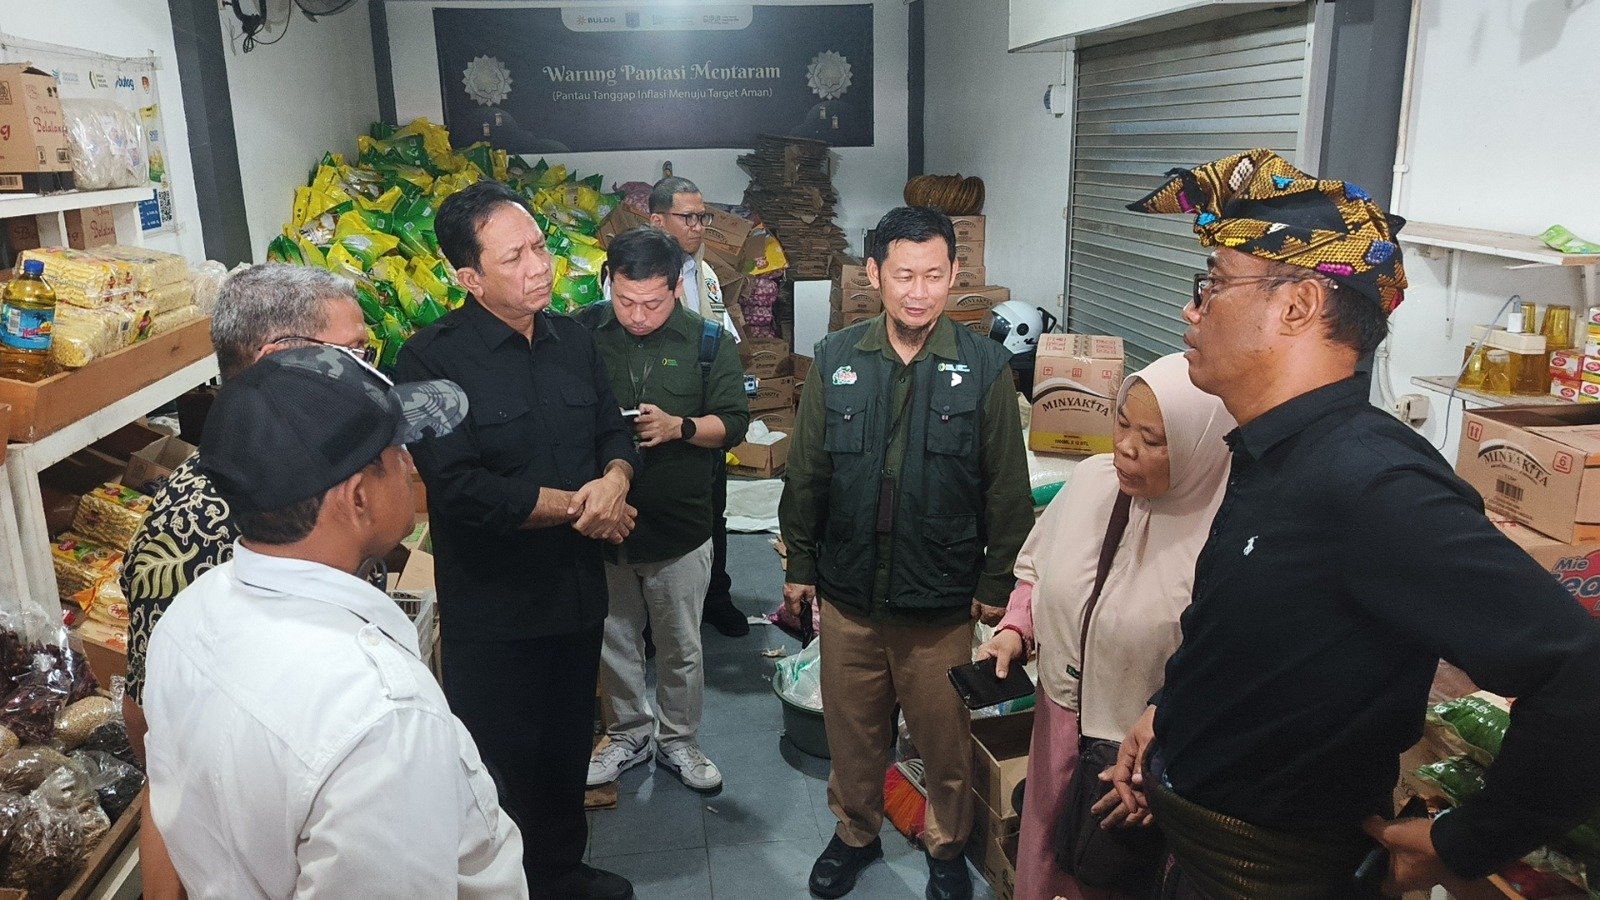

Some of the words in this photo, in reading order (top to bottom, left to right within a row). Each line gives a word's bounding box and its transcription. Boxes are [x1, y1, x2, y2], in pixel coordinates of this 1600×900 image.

[587, 16, 616, 24] BULOG
[542, 65, 618, 87] Warung
[620, 63, 686, 82] Pantasi
[690, 59, 781, 81] Mentaram
[552, 90, 591, 102] (Pantau
[592, 90, 636, 102] Tanggap
[637, 89, 667, 100] Inflasi
[669, 88, 707, 100] Menuju
[708, 87, 739, 100] Target
[740, 87, 773, 98] Aman)
[1042, 397, 1110, 417] MINYAKITA
[1552, 556, 1590, 573] Mie
